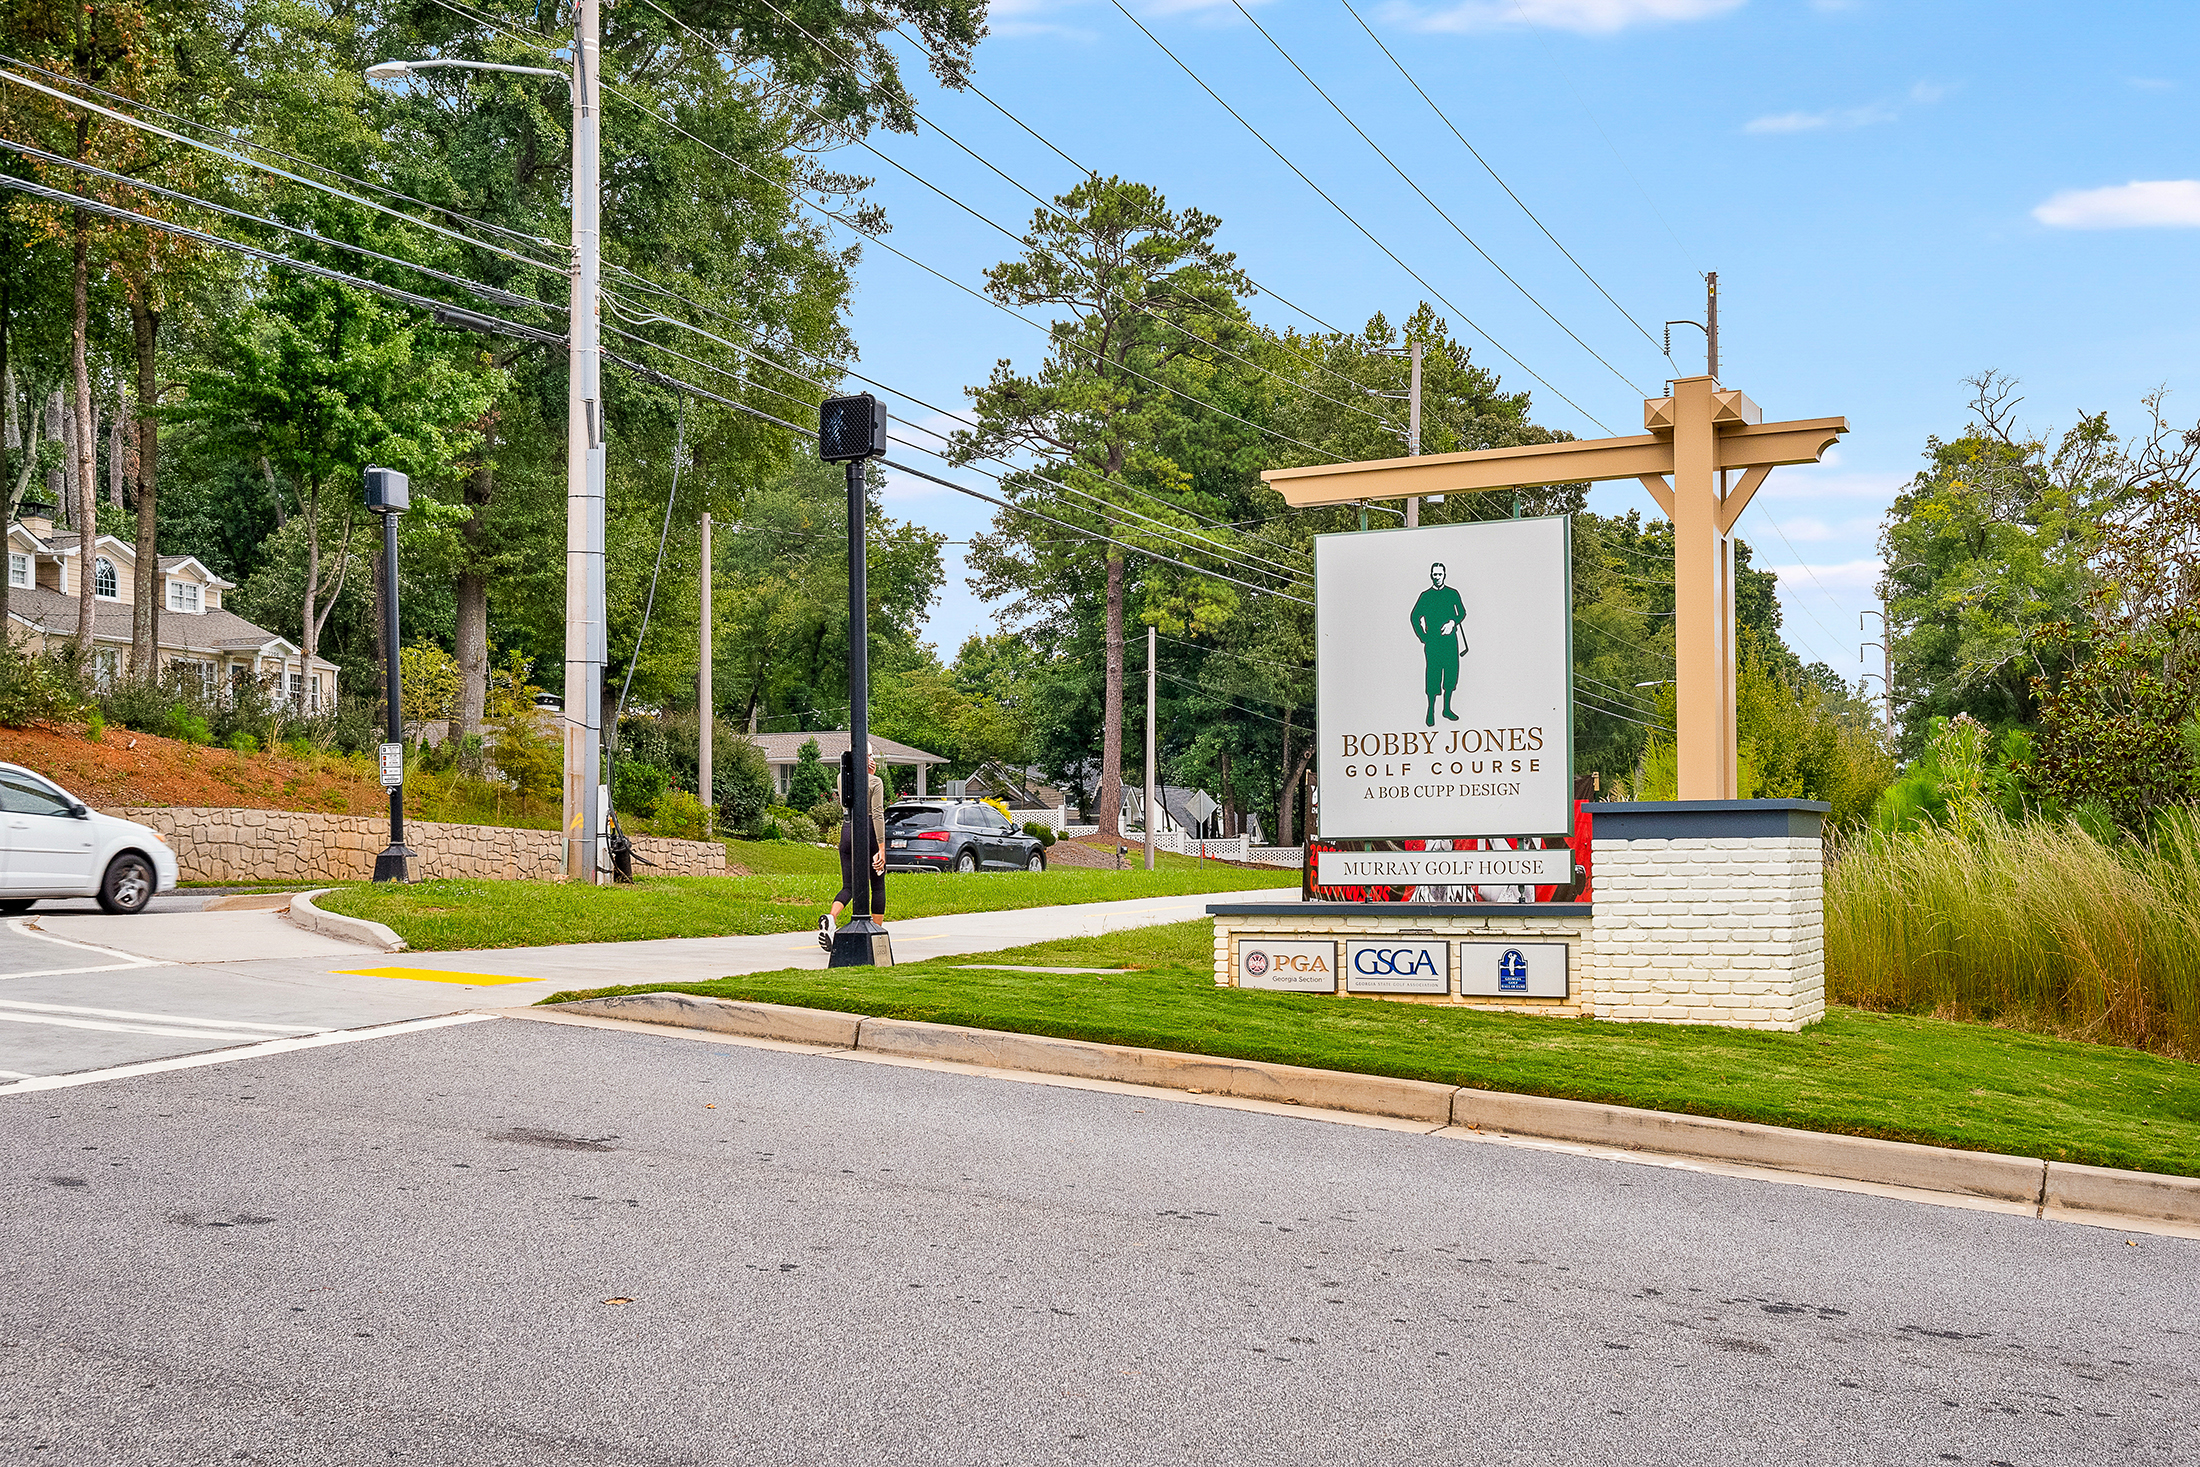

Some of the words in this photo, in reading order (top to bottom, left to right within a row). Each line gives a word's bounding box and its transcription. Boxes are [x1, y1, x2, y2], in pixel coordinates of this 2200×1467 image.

[1342, 731, 1439, 757] BOBBY
[1445, 727, 1543, 754] JONES
[1345, 763, 1411, 777] GOLF
[1431, 759, 1540, 775] COURSE
[1364, 787, 1375, 799] A
[1378, 786, 1410, 799] BOB
[1413, 785, 1455, 798] CUPP
[1459, 783, 1521, 797] DESIGN
[1343, 861, 1421, 876] MURRAY
[1425, 861, 1474, 876] GOLF
[1479, 860, 1544, 875] HOUSE
[1273, 955, 1329, 973] PGA
[1354, 948, 1439, 976] GSGA
